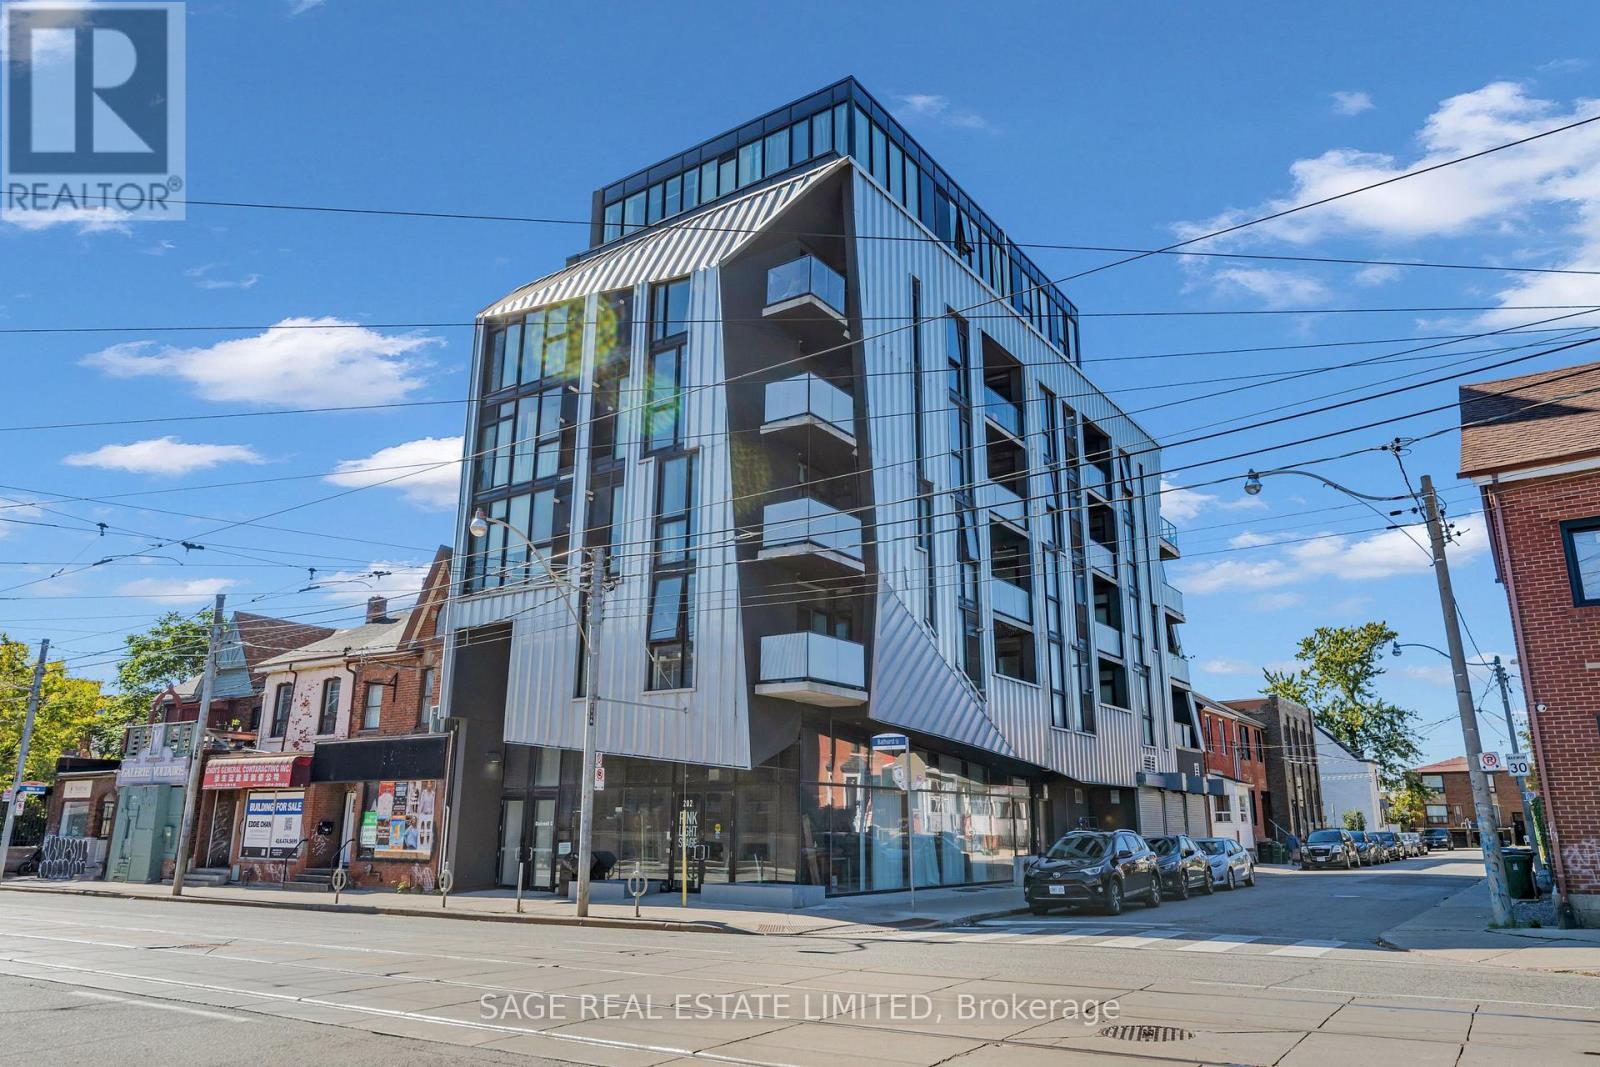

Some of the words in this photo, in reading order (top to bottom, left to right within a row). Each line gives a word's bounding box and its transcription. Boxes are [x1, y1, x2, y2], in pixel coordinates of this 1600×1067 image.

[121, 766, 151, 777] GALERIE
[1510, 762, 1527, 774] 30
[250, 802, 274, 812] BUILDING
[276, 802, 287, 811] FOR
[288, 802, 302, 811] SALE
[682, 799, 693, 807] 202
[679, 811, 698, 825] PNK
[248, 820, 260, 828] EDDIE
[260, 820, 271, 828] CHAN
[678, 825, 698, 837] LGHT
